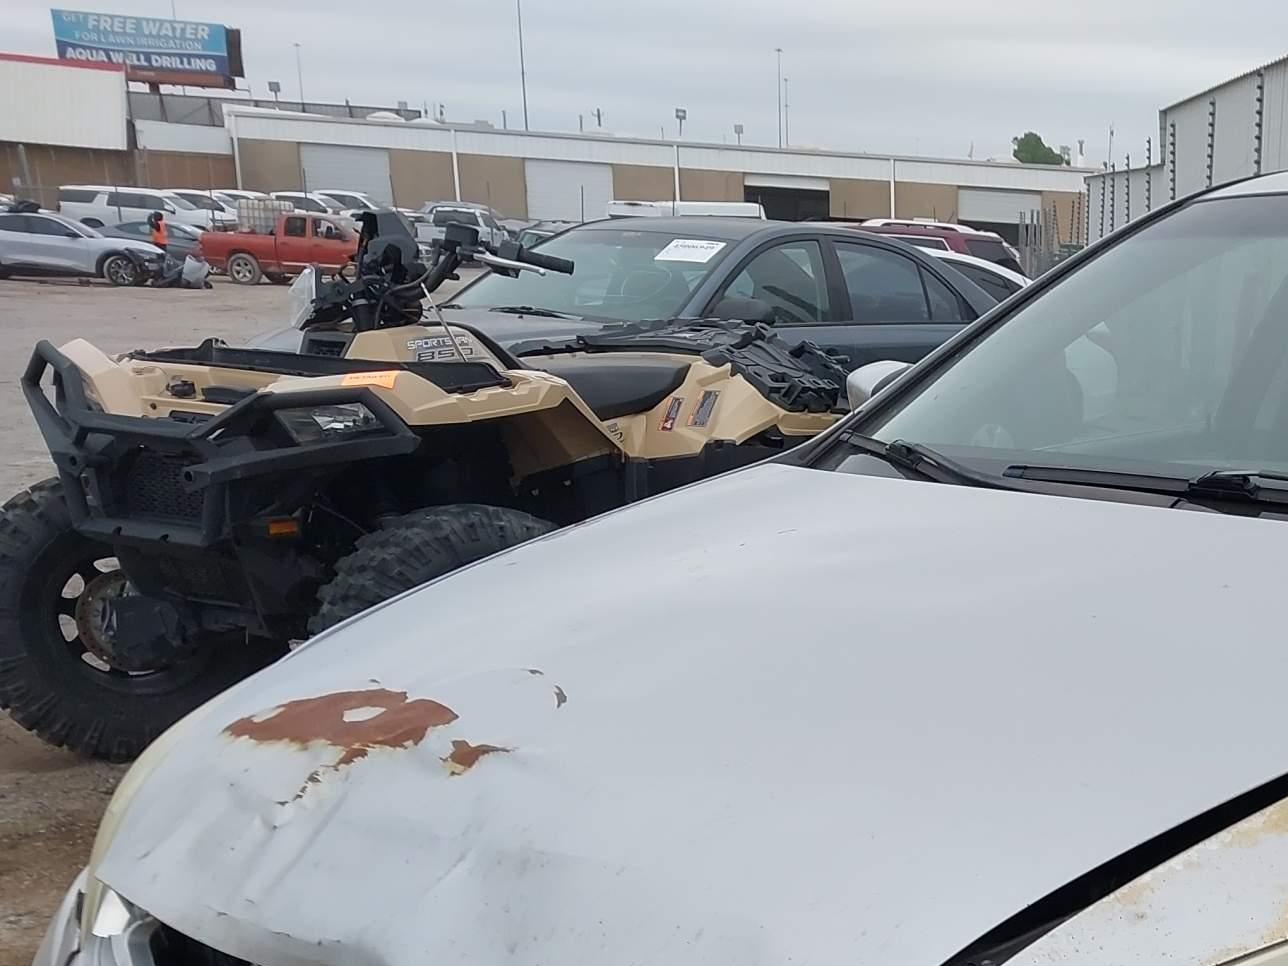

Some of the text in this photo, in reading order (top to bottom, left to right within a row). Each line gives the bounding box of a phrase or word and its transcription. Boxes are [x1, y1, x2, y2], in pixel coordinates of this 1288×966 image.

[63, 13, 209, 40] GET FREE WATER
[74, 30, 202, 50] FOR LAWN IRRIGATION
[66, 46, 108, 62] AQUA
[150, 53, 217, 71] DRILLING
